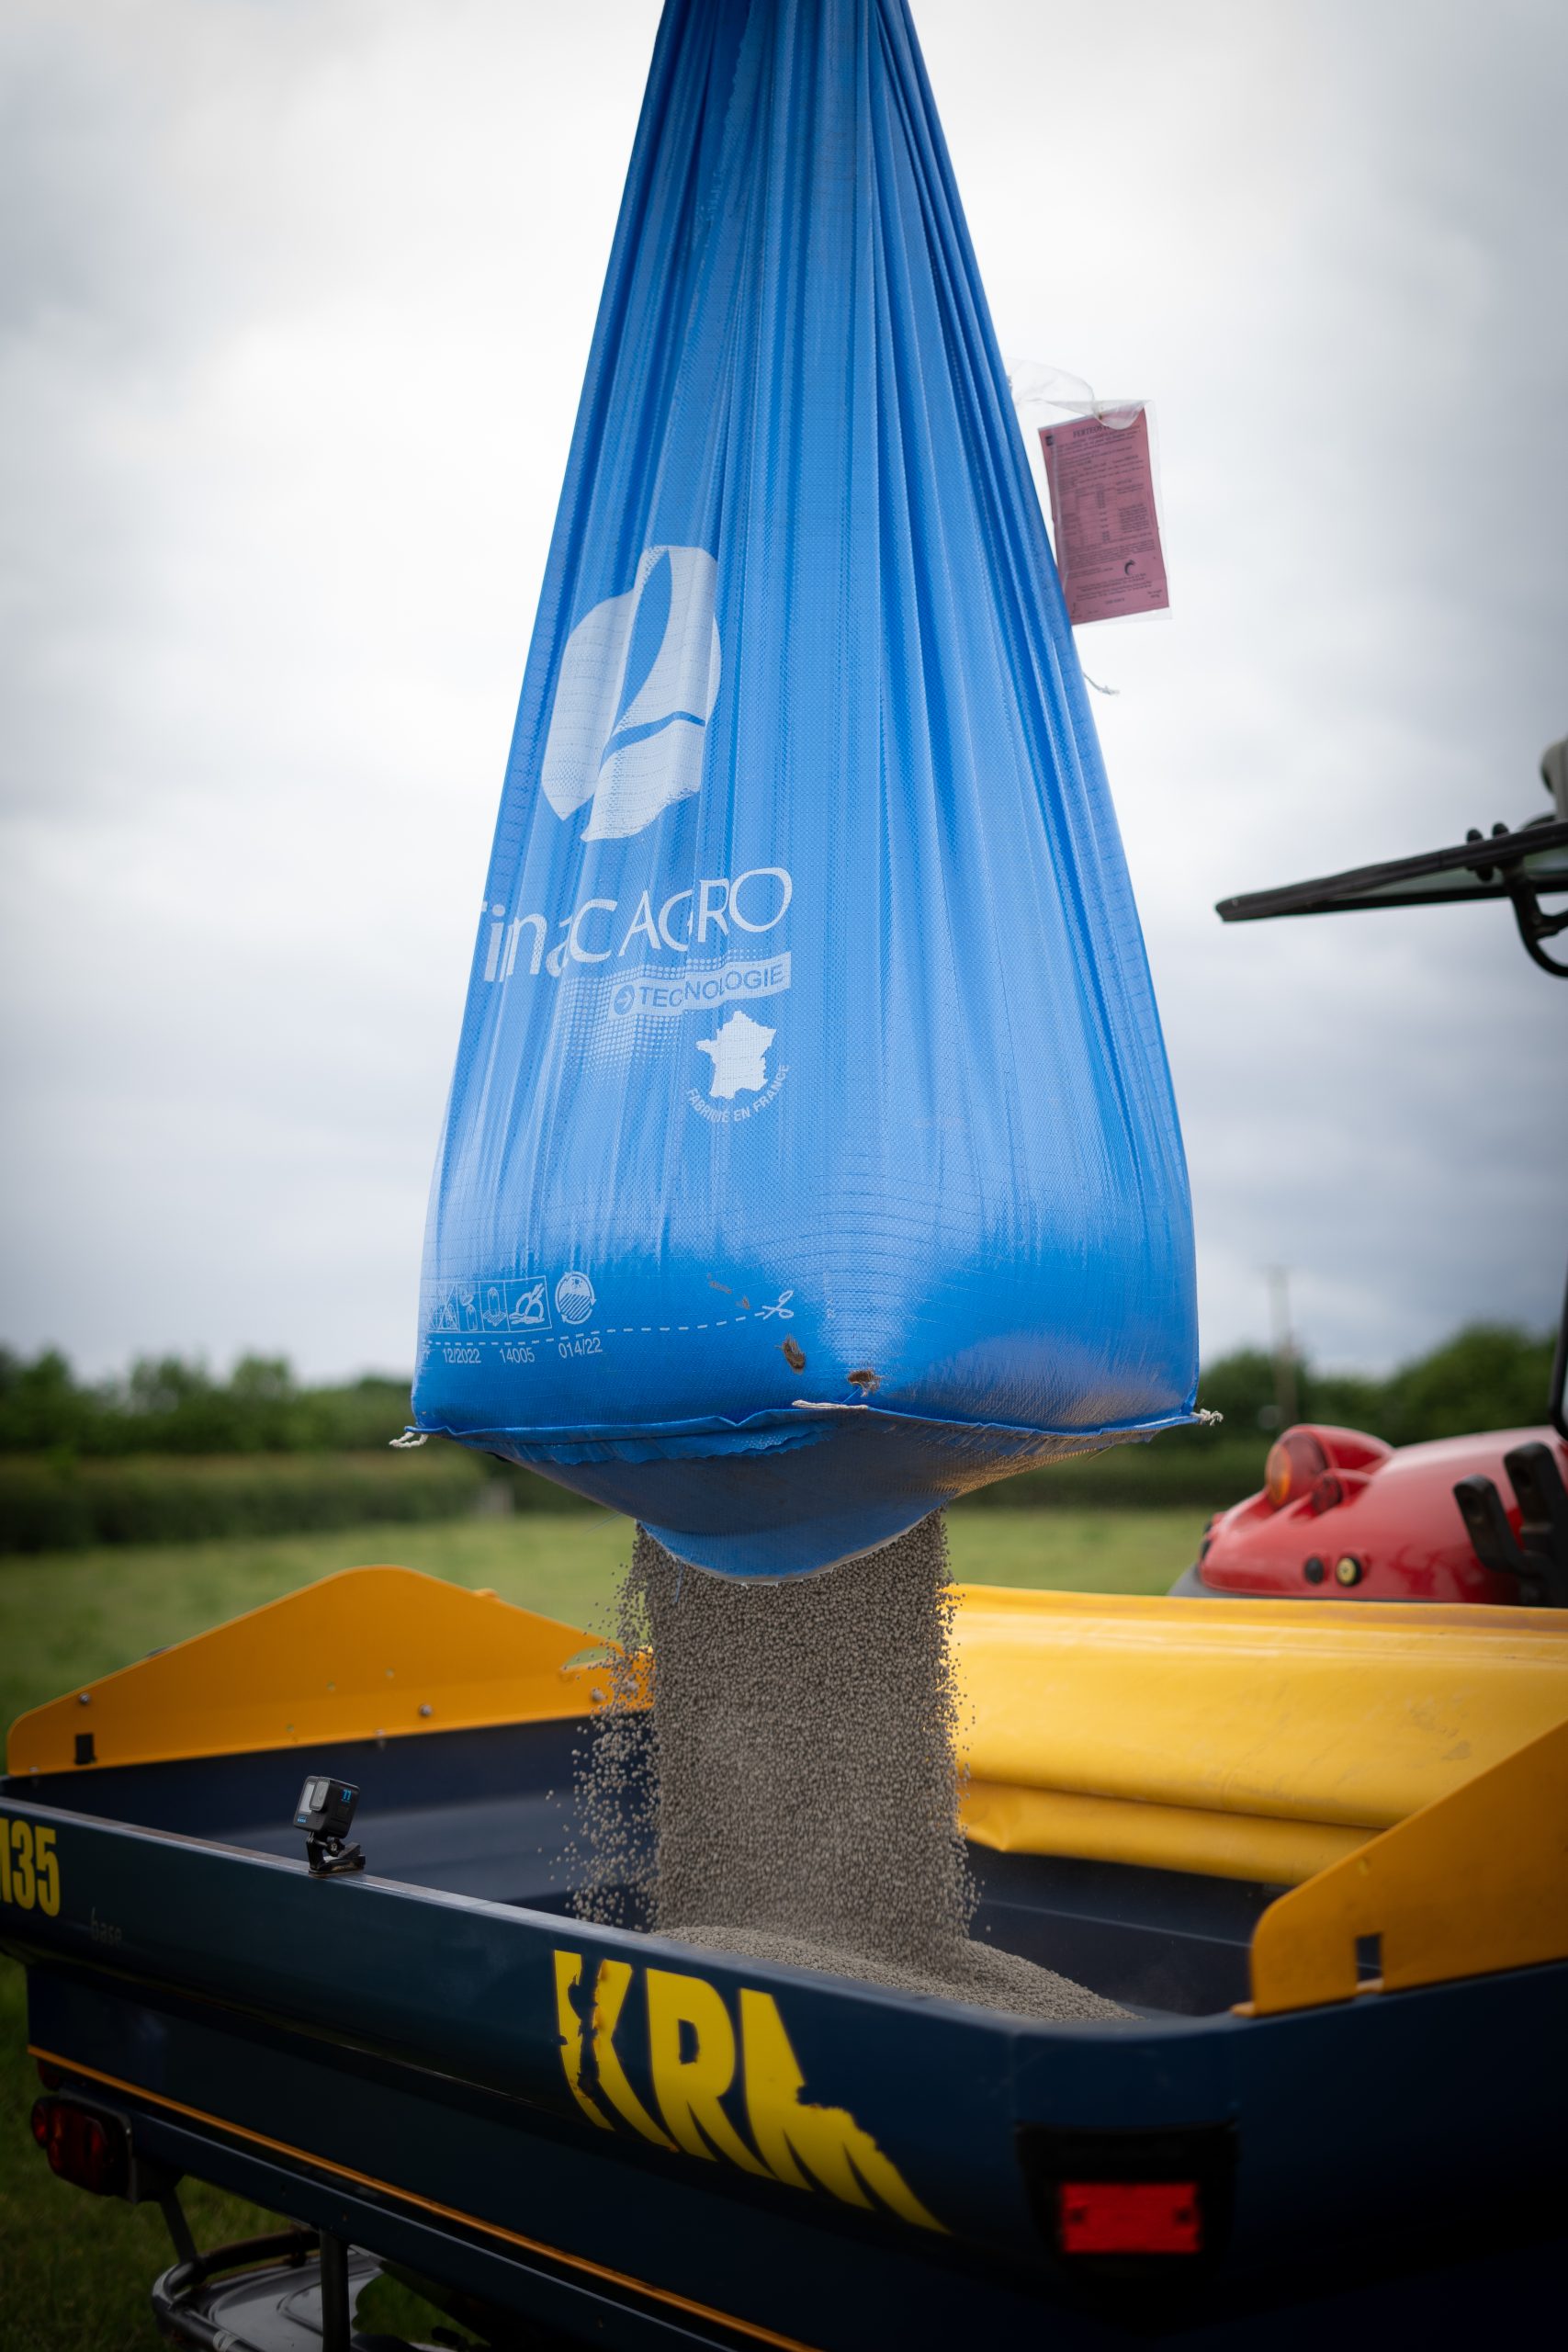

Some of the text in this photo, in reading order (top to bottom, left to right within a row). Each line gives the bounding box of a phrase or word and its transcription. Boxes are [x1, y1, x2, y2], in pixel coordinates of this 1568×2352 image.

[618, 867, 793, 956] AGRO
[733, 1106, 751, 1122] EN
[751, 1064, 790, 1113] FRANCE
[442, 1337, 603, 1363] 12/2022 14005 014/22
